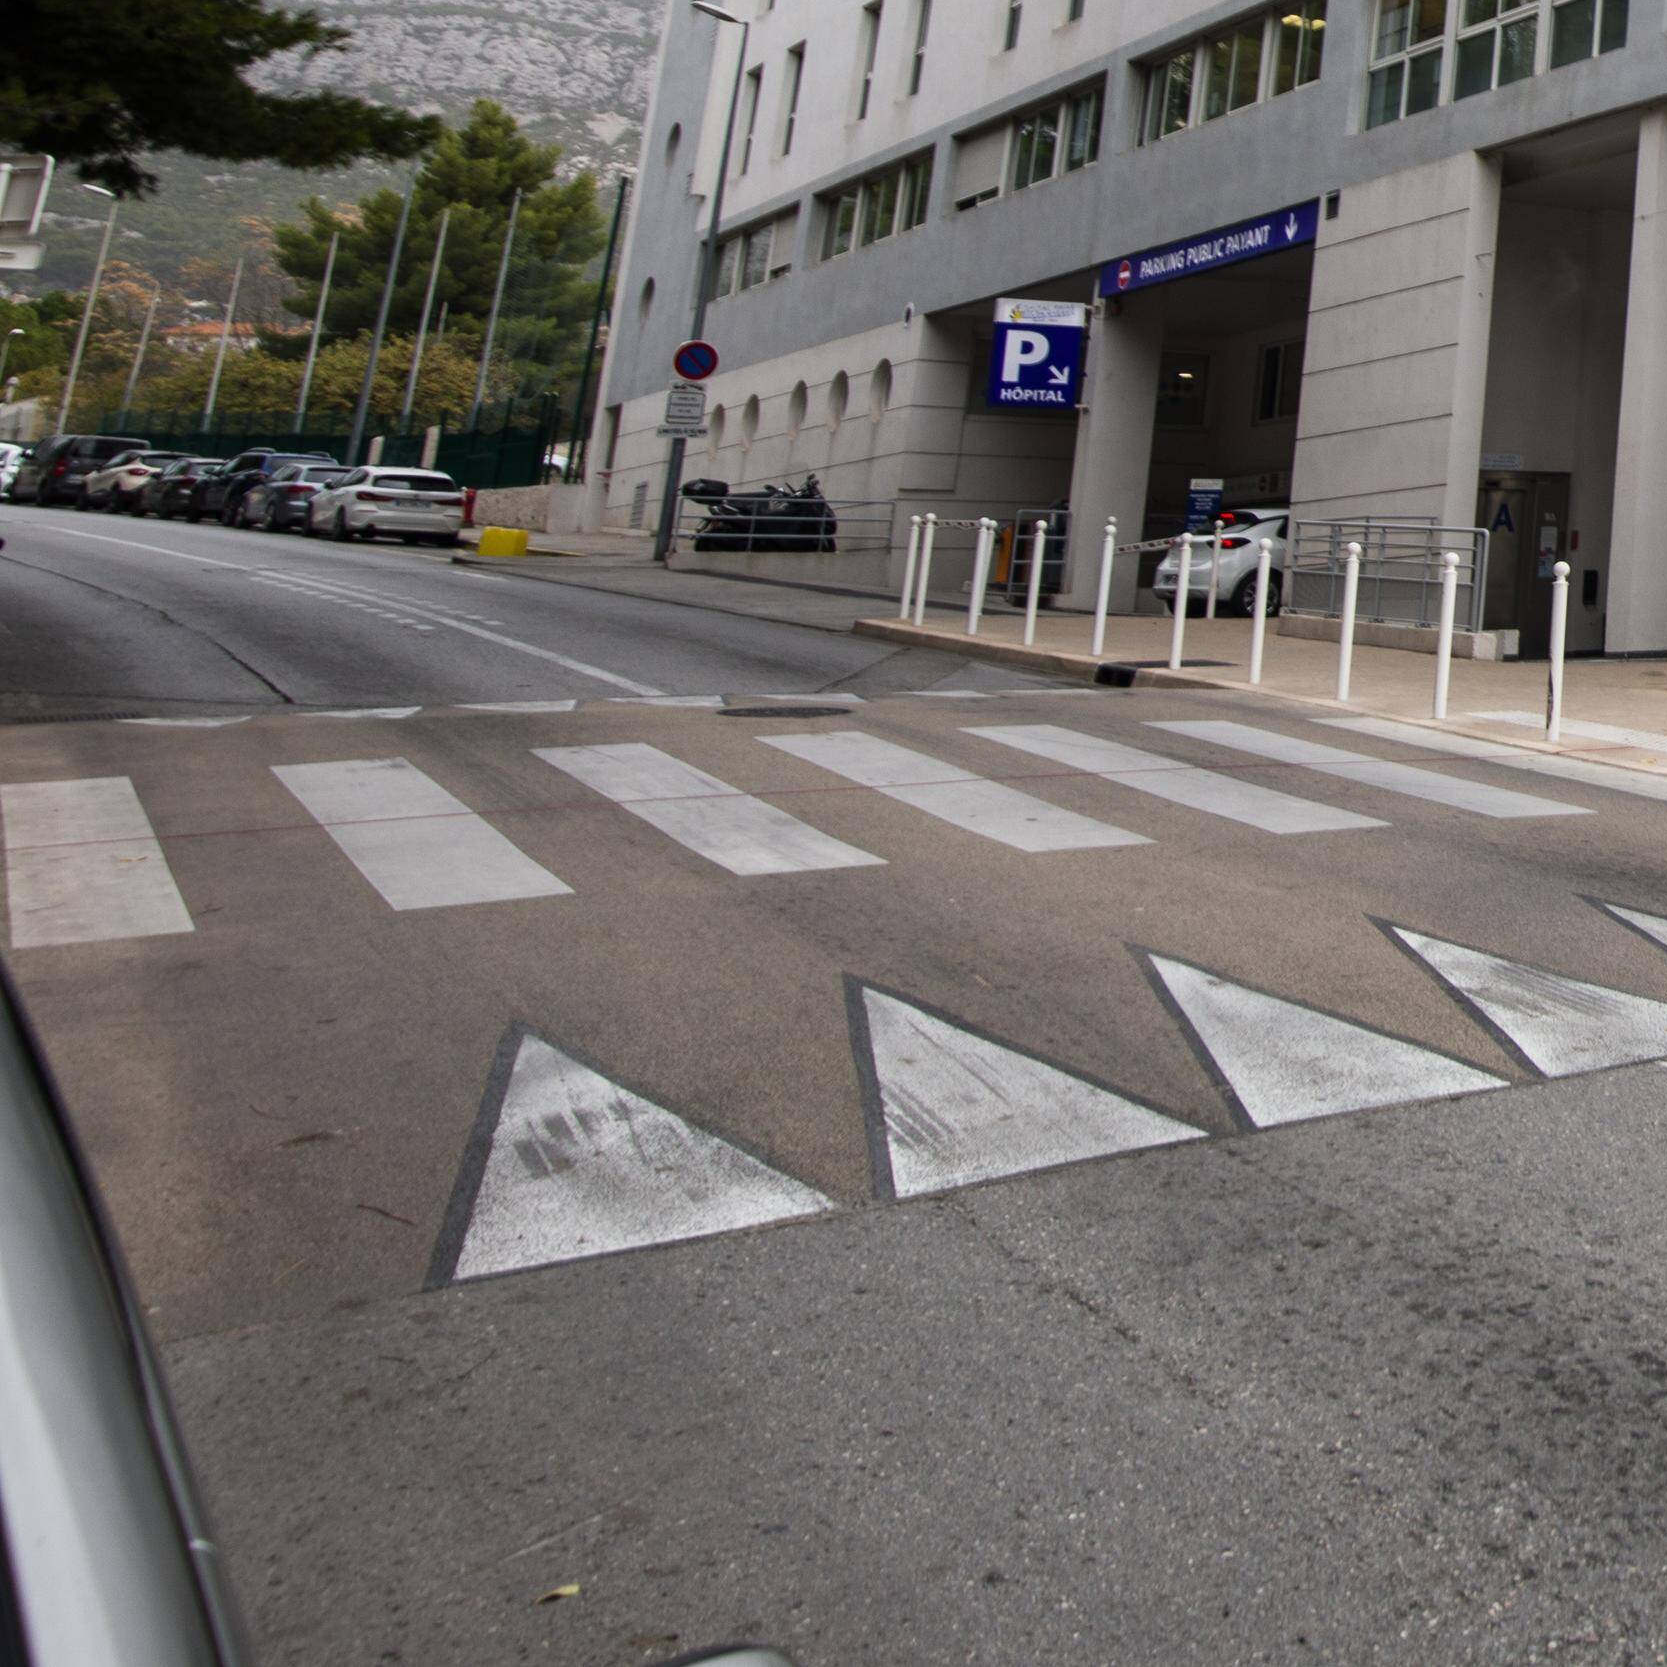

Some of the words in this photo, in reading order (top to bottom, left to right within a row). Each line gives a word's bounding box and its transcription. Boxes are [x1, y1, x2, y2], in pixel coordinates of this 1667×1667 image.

[1140, 249, 1186, 279] PARKING
[1186, 238, 1225, 266] PUBLIC
[1225, 224, 1271, 254] PAYANT
[1001, 329, 1050, 383] P
[1000, 385, 1066, 403] HÔPITAL
[1491, 502, 1515, 533] A
